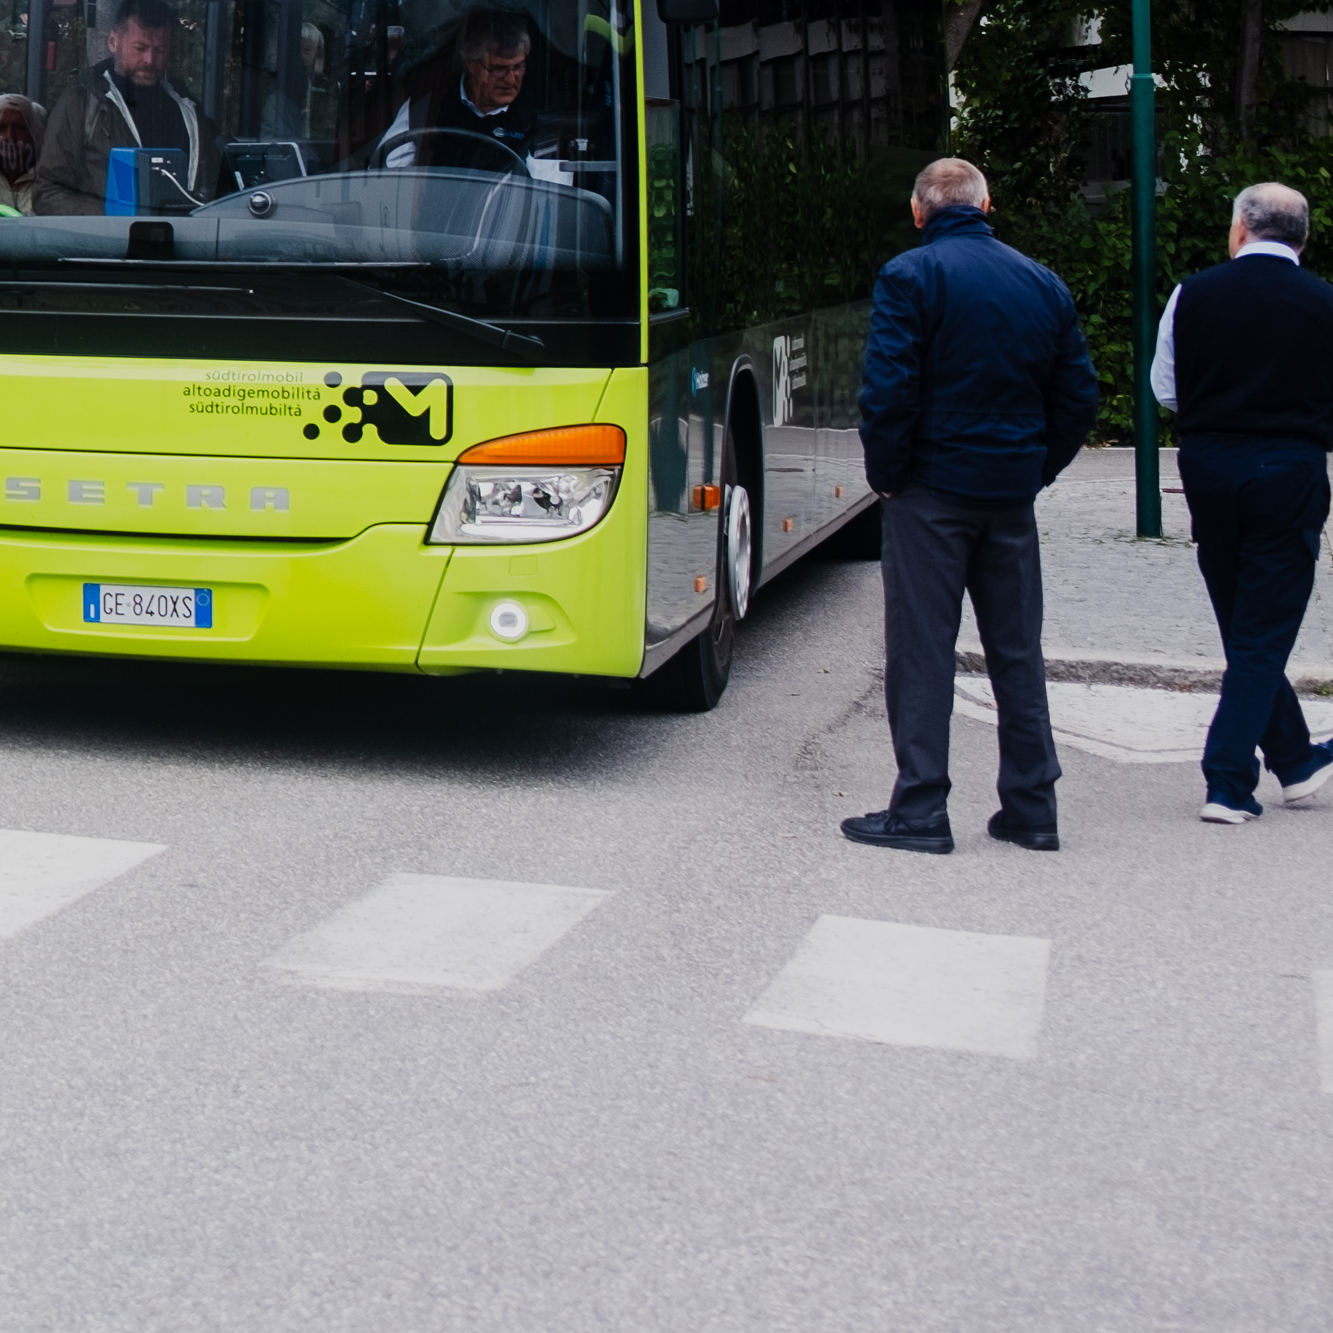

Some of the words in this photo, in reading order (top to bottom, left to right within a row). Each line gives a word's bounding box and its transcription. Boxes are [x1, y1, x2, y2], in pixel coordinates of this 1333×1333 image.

[205, 369, 304, 384] südtirolmobil
[182, 383, 322, 402] altoadigemobilità
[189, 401, 303, 418] südtirolmubiltà
[4, 477, 291, 513] SETRA
